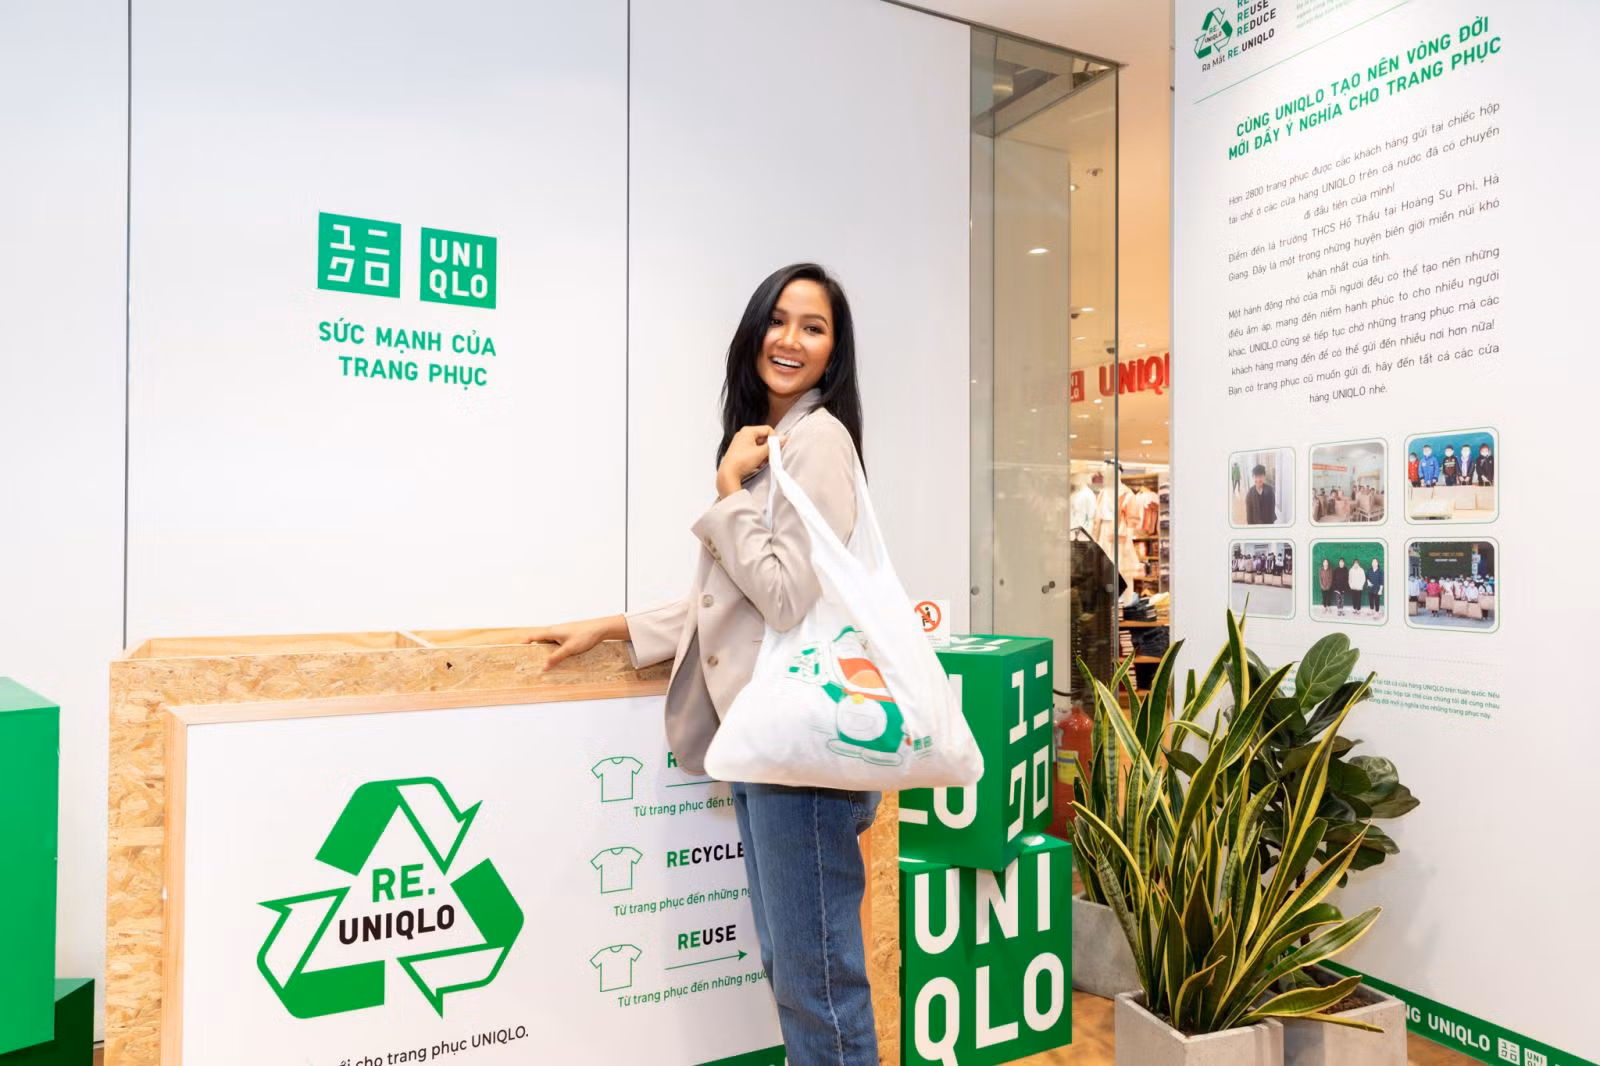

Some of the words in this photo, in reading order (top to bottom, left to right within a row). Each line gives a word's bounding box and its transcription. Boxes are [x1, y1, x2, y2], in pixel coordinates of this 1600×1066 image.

[1237, 8, 1276, 37] REDUCE
[1236, 112, 1270, 137] CÙNG
[1275, 88, 1324, 120] UNIQLO
[1331, 72, 1361, 97] TẠO
[1367, 55, 1399, 82] NÊN
[1407, 33, 1451, 64] VÒNG
[1459, 16, 1488, 43] ĐỜI
[1228, 139, 1249, 160] MỚI
[1254, 126, 1280, 150] ĐẦY
[1286, 119, 1293, 136] Ý
[1299, 103, 1343, 132] NGHĨA
[1349, 87, 1379, 112] CHO
[1386, 61, 1443, 96] TRANG
[1451, 37, 1501, 71] PHỤC
[430, 237, 483, 269] UNI
[429, 268, 488, 299] QLO
[319, 317, 365, 345] SỨC
[376, 326, 442, 354] MẠNH
[452, 329, 497, 356] CỦA
[339, 356, 418, 381] TRANG
[429, 363, 487, 390] PHỤC
[634, 805, 647, 817] Từ
[649, 803, 676, 816] trang
[679, 800, 703, 814] phục
[706, 796, 725, 809] đến
[666, 843, 744, 868] RECYCLE
[372, 863, 435, 903] RE.
[614, 904, 627, 916] Từ
[629, 902, 657, 914] trang
[659, 898, 684, 912] phục
[687, 893, 706, 905] đến
[708, 889, 739, 904] những
[914, 852, 1050, 955] UNI
[338, 904, 455, 945] UNIQLO
[677, 924, 737, 950] REUSE
[617, 996, 631, 1008] Từ
[633, 991, 662, 1005] trang
[664, 985, 688, 1001] phục
[691, 980, 710, 992] đến
[712, 974, 743, 990] những
[914, 952, 1064, 1066] QLO
[387, 1047, 427, 1063] trang
[432, 1040, 467, 1060] phục
[471, 1025, 529, 1048] UNIQLO.
[1428, 1012, 1490, 1052] UNIQLO
